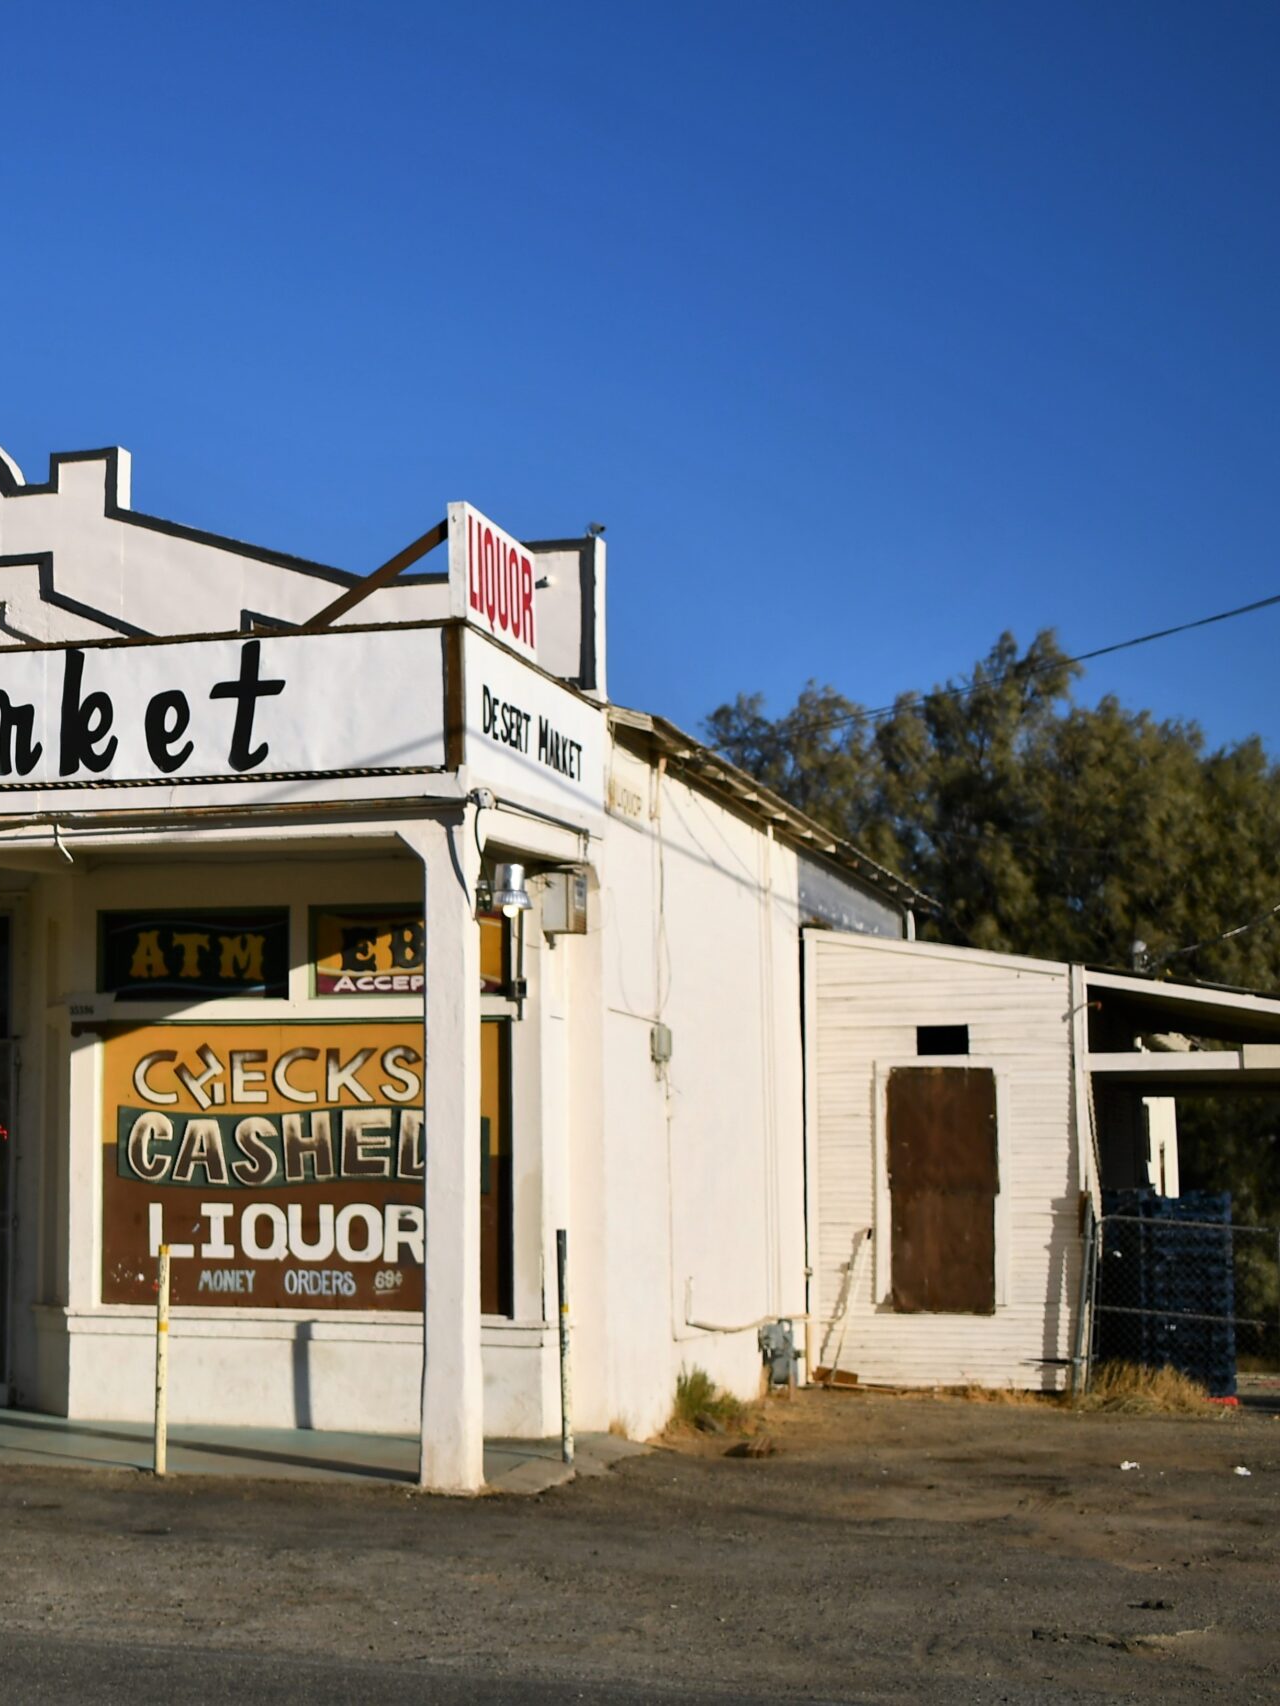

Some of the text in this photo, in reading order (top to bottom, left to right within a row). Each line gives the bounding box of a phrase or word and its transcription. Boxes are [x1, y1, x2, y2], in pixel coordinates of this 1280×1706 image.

[467, 514, 536, 649] LIQUOR
[482, 683, 583, 782] DESERT MARKET
[129, 930, 266, 981] ATM
[341, 920, 424, 973] EB
[132, 1042, 424, 1112] CHECKS
[198, 1269, 257, 1293] MONEY
[284, 1269, 358, 1296] ORDERS
